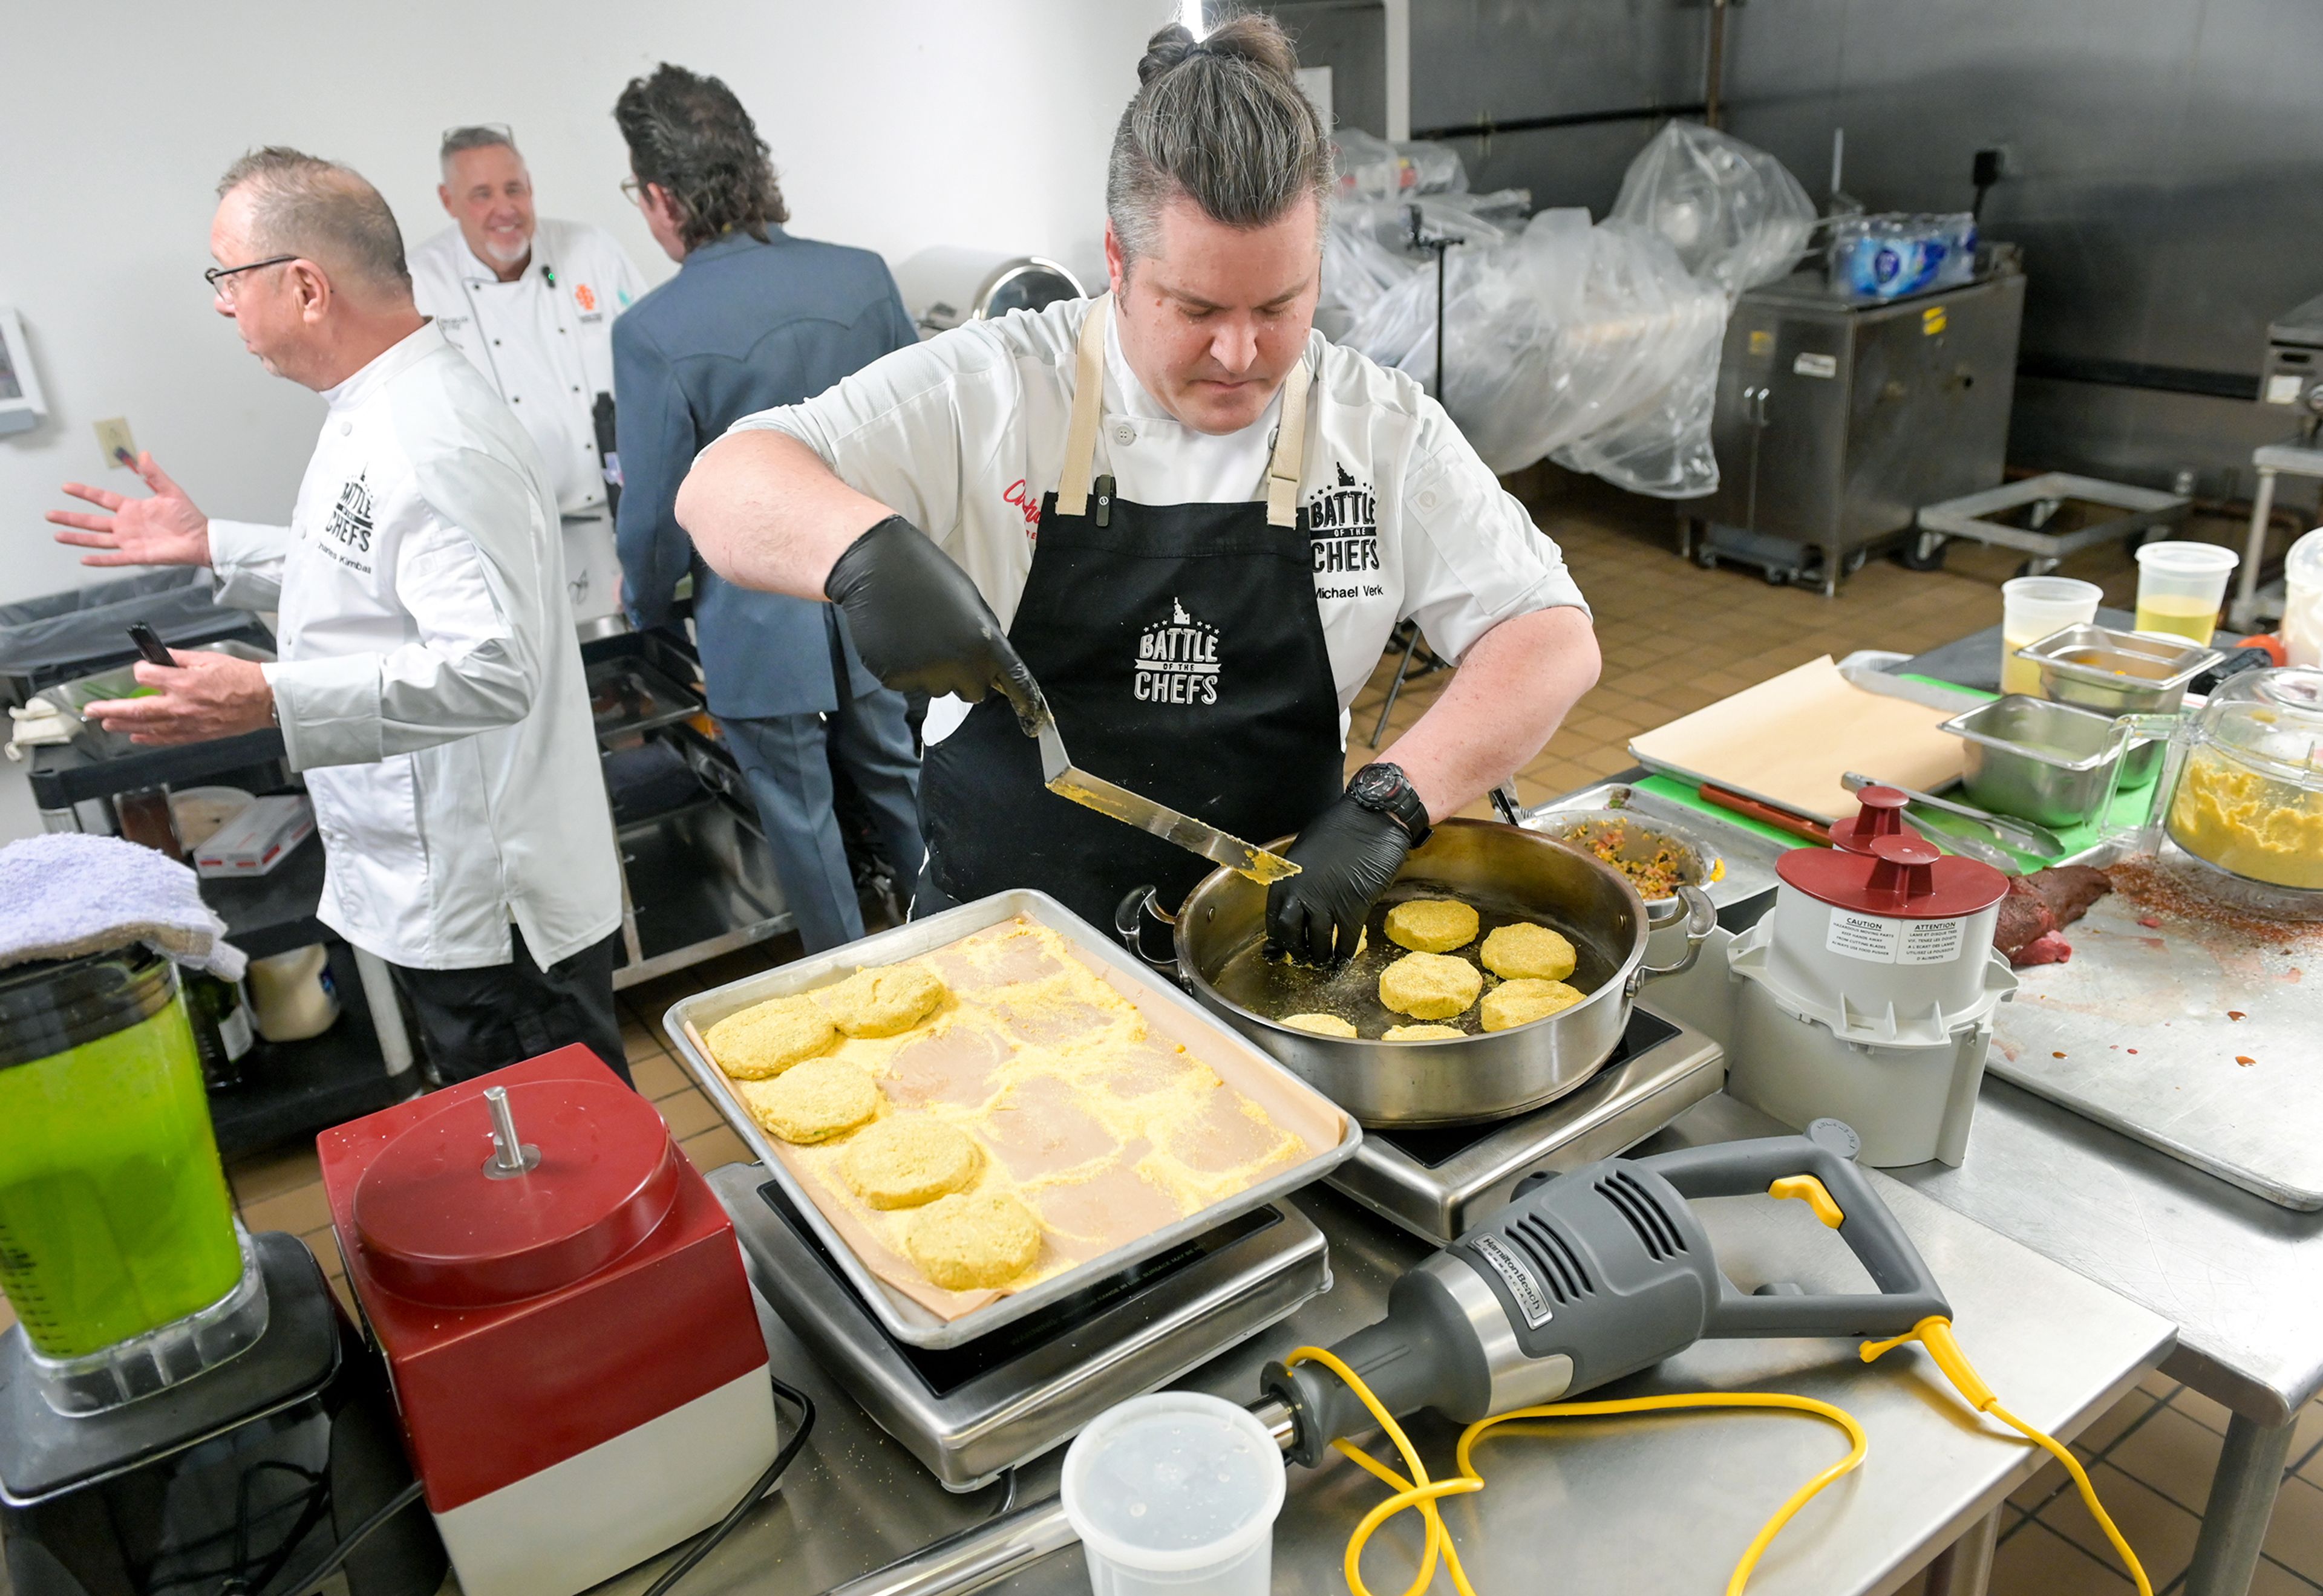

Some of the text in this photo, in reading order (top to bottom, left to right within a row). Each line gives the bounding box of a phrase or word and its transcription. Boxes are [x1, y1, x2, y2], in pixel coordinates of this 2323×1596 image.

[1310, 490, 1376, 528] BATTLE
[326, 510, 371, 552] CHEFS
[1334, 527, 1366, 537] OF THE
[1311, 538, 1379, 573] CHEFS
[1363, 584, 1384, 597] Verk
[1139, 628, 1218, 662] BATTLE
[1134, 671, 1218, 705] CHEFS
[1847, 917, 1882, 929] CAUTION
[1482, 1248, 1527, 1305] COMMERCIAL
[1483, 1238, 1540, 1311] Hamilton Beach
